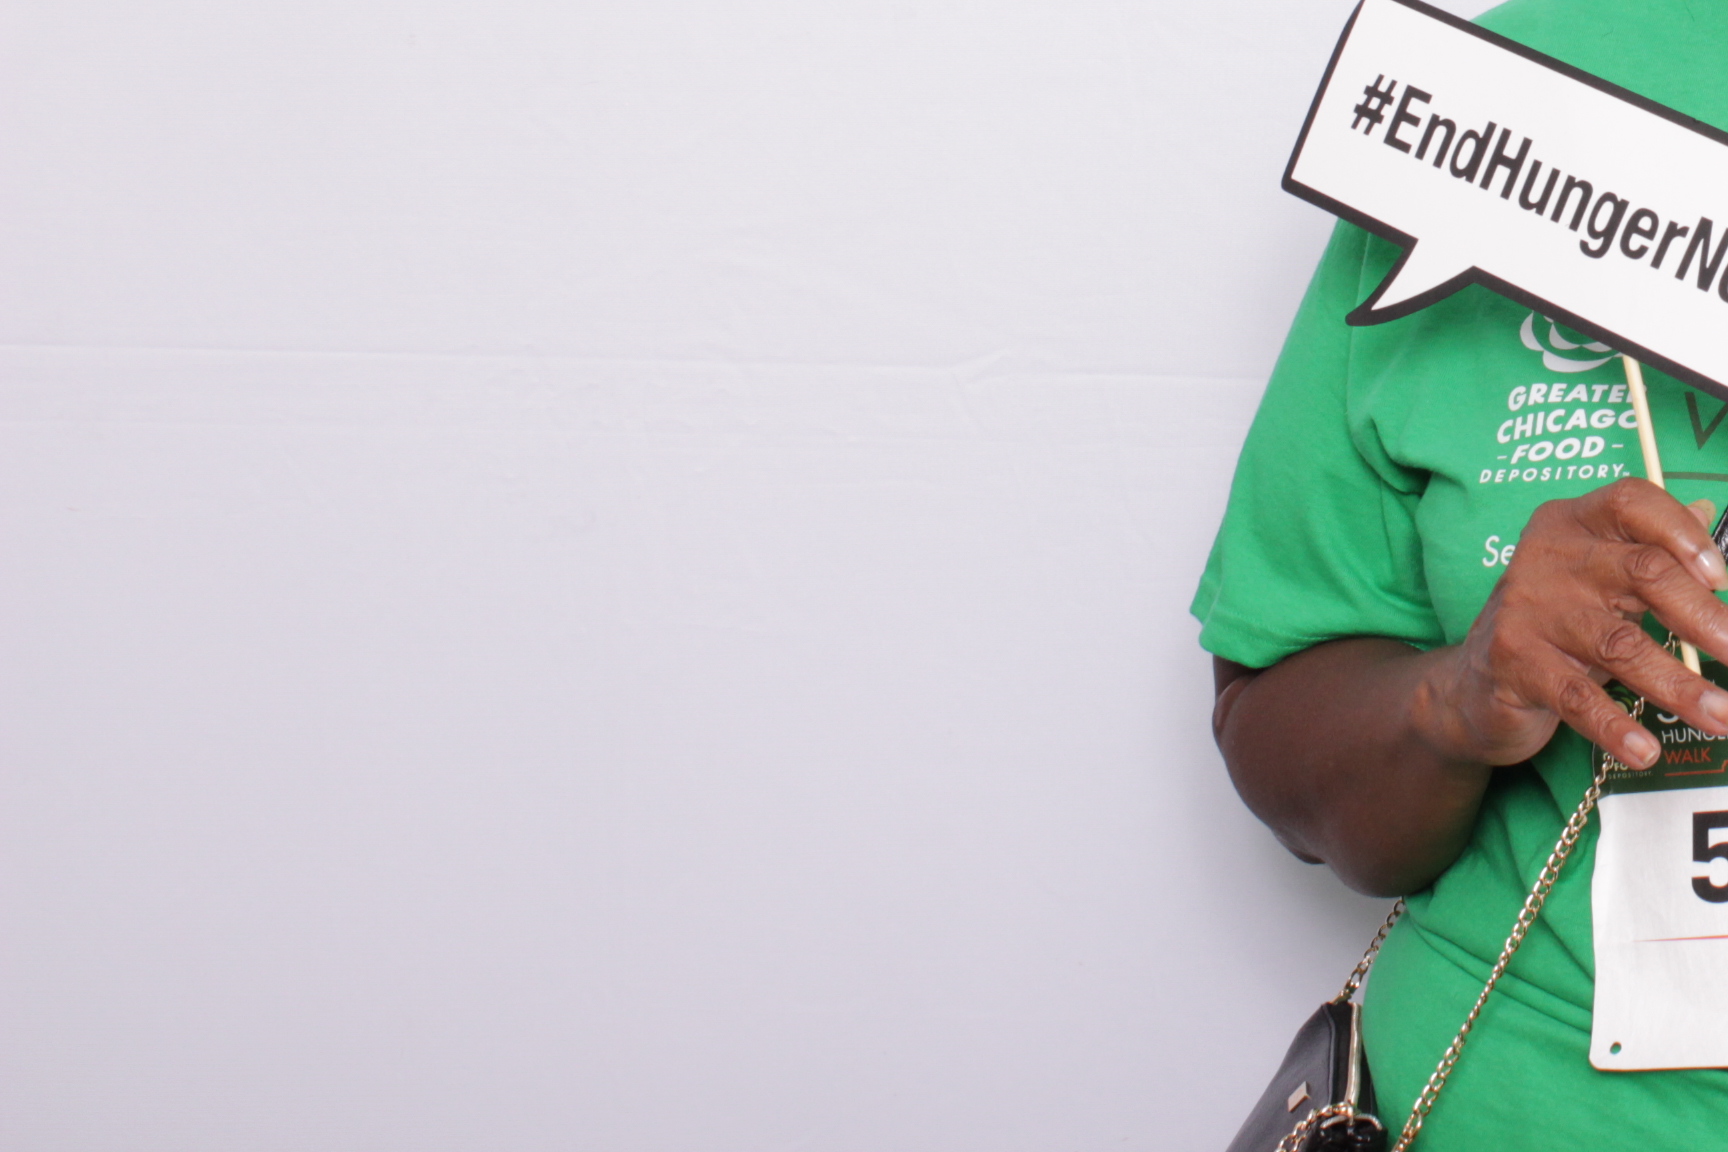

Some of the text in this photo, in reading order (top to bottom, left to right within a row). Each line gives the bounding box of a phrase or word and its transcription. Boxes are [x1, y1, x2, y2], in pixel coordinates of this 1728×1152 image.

[1497, 408, 1640, 444] CHICAGO
[1479, 463, 1625, 483] DEPOSITORY
[1664, 747, 1713, 765] WALK
